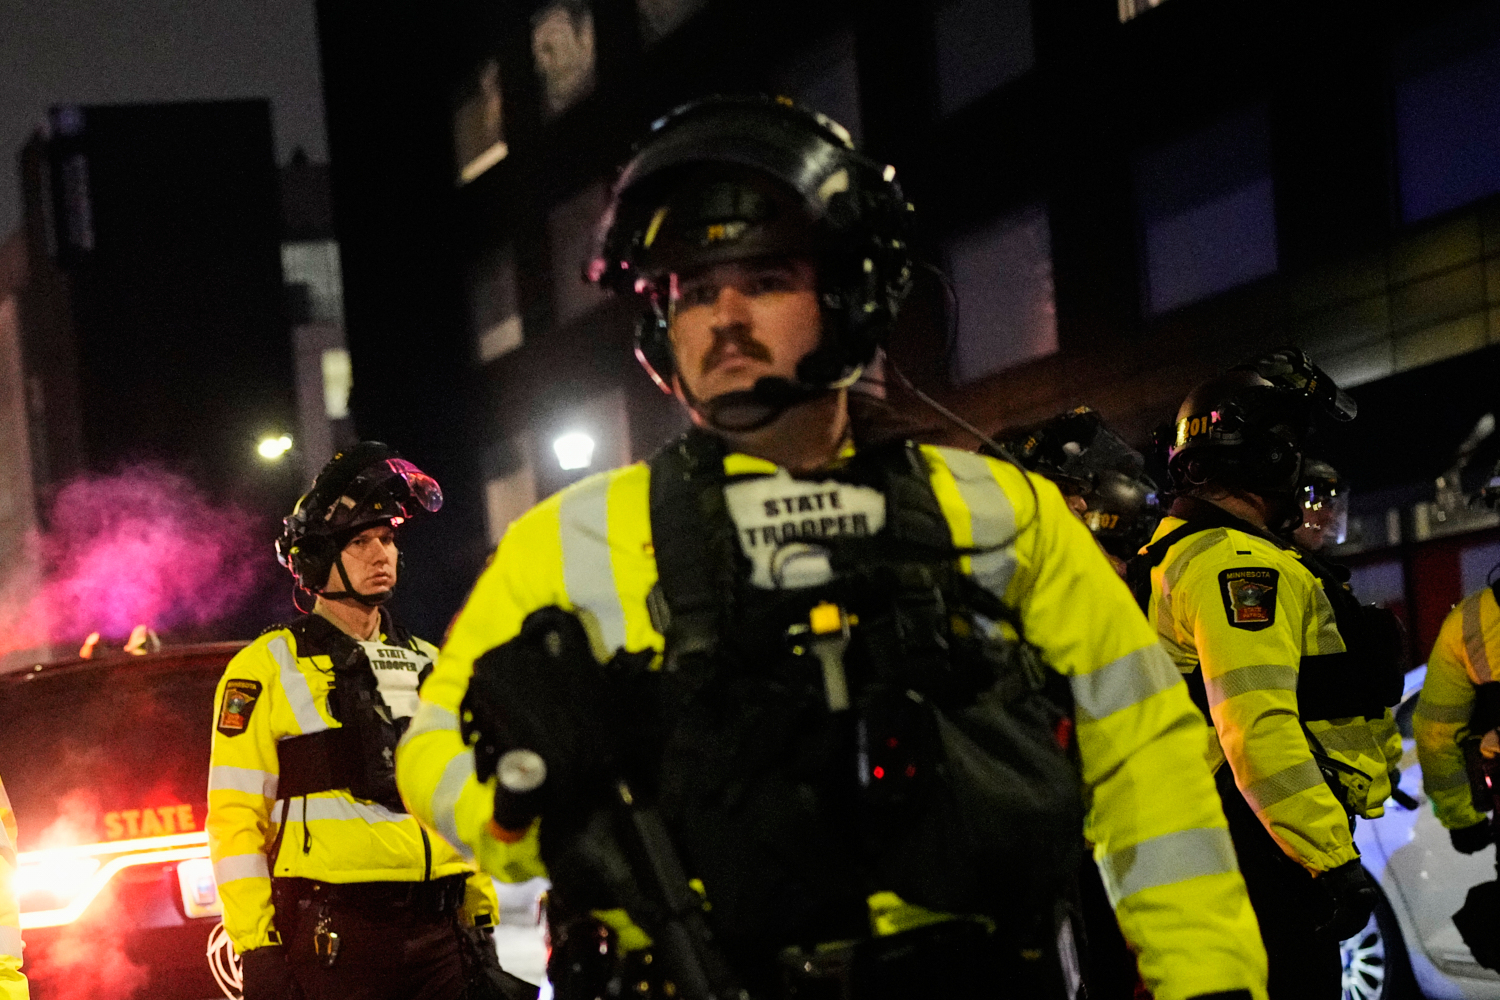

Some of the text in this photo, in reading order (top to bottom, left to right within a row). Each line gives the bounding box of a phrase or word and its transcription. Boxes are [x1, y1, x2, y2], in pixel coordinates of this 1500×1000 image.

[763, 491, 842, 517] STATE
[745, 511, 868, 547] TROOPER
[1226, 571, 1270, 579] MINNESOTA
[376, 648, 407, 659] STATE
[371, 660, 418, 672] TROOPER
[104, 803, 197, 840] STATE
